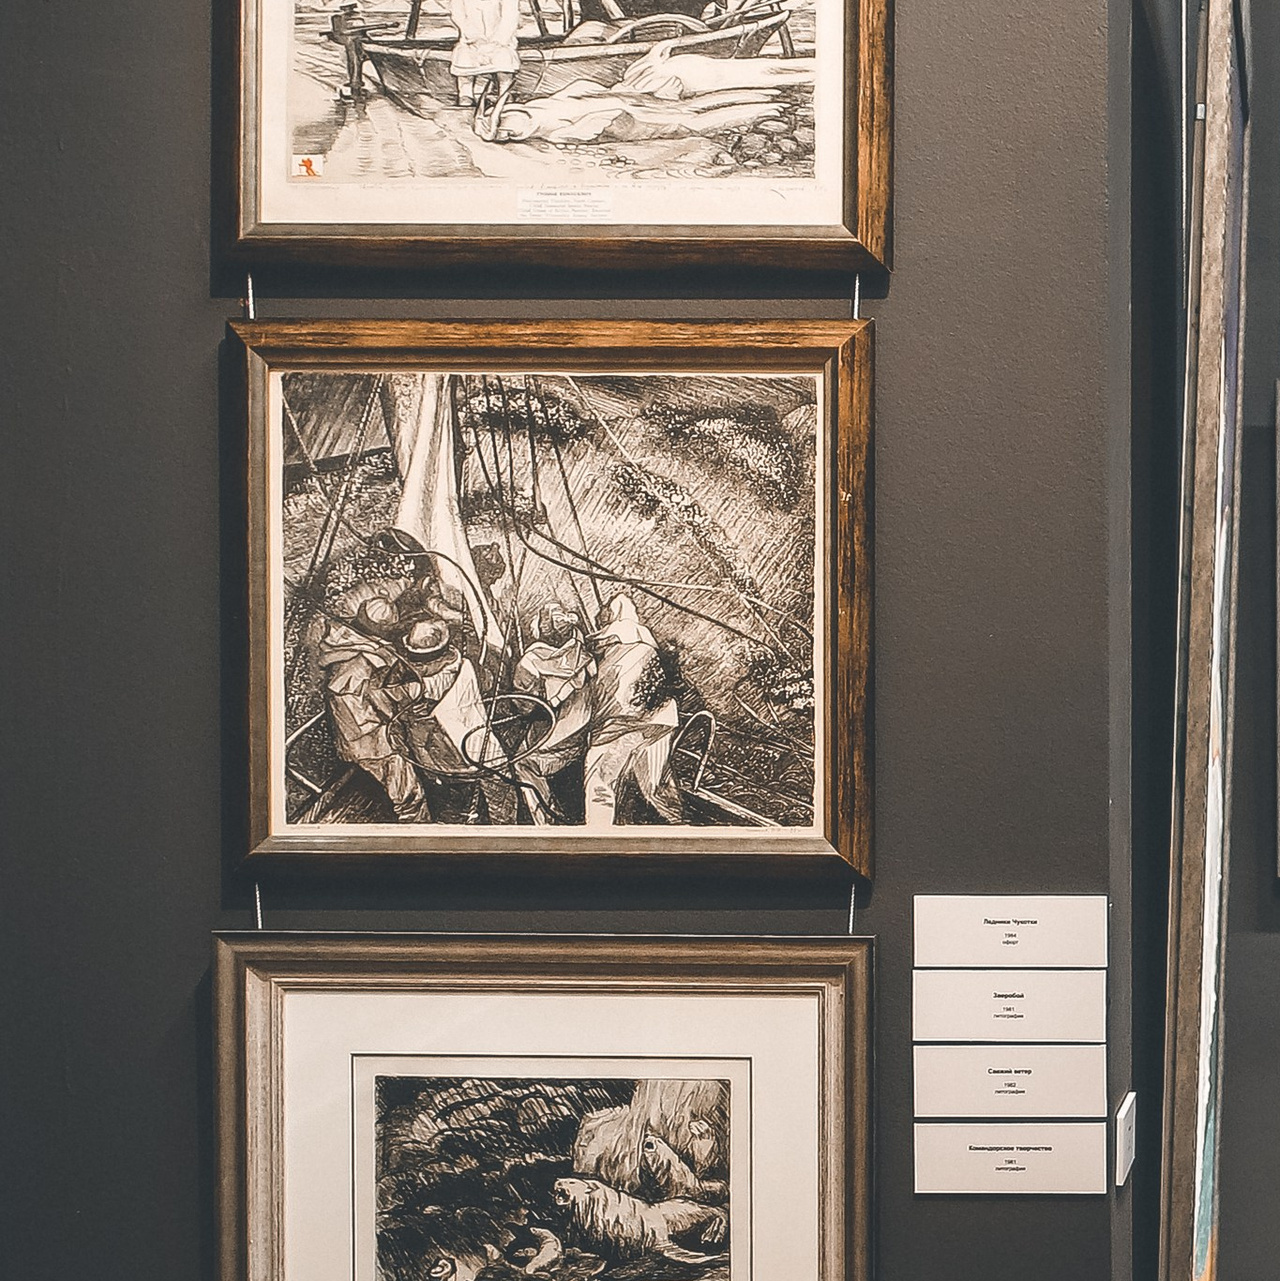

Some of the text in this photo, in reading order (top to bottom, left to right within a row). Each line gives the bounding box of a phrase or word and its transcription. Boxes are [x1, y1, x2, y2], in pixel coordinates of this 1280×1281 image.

[1012, 918, 1038, 927] Чукотки
[992, 991, 1025, 1000] Зверобой
[987, 1067, 1013, 1076] Свежий
[968, 1144, 1053, 1153] Командорское творчество
